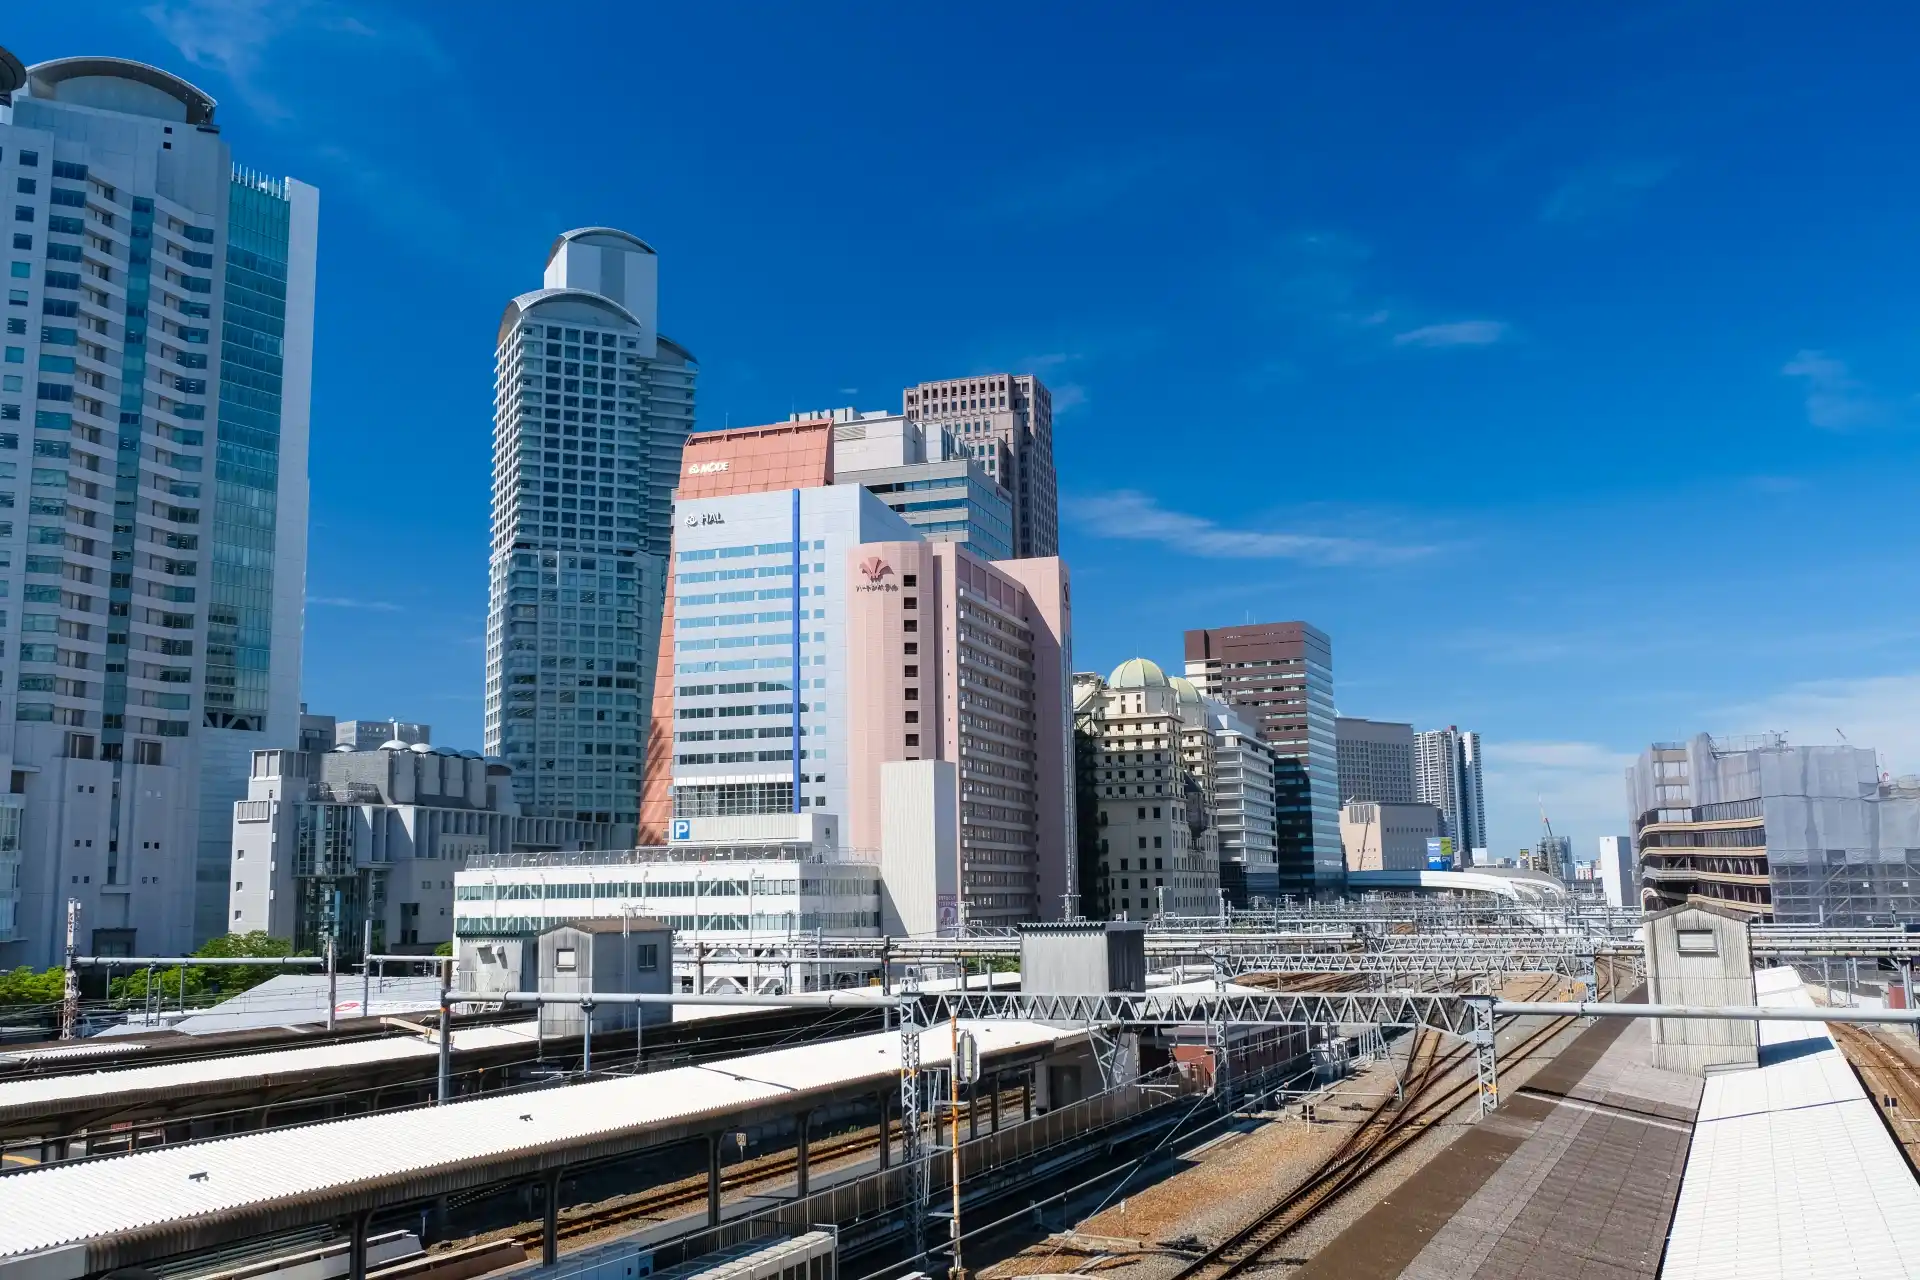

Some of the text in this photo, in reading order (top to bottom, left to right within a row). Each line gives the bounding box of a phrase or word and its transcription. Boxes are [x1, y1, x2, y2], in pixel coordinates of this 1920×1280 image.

[700, 461, 729, 474] MODE
[701, 512, 725, 526] HAL
[675, 821, 688, 839] P
[737, 1133, 745, 1143] 60
